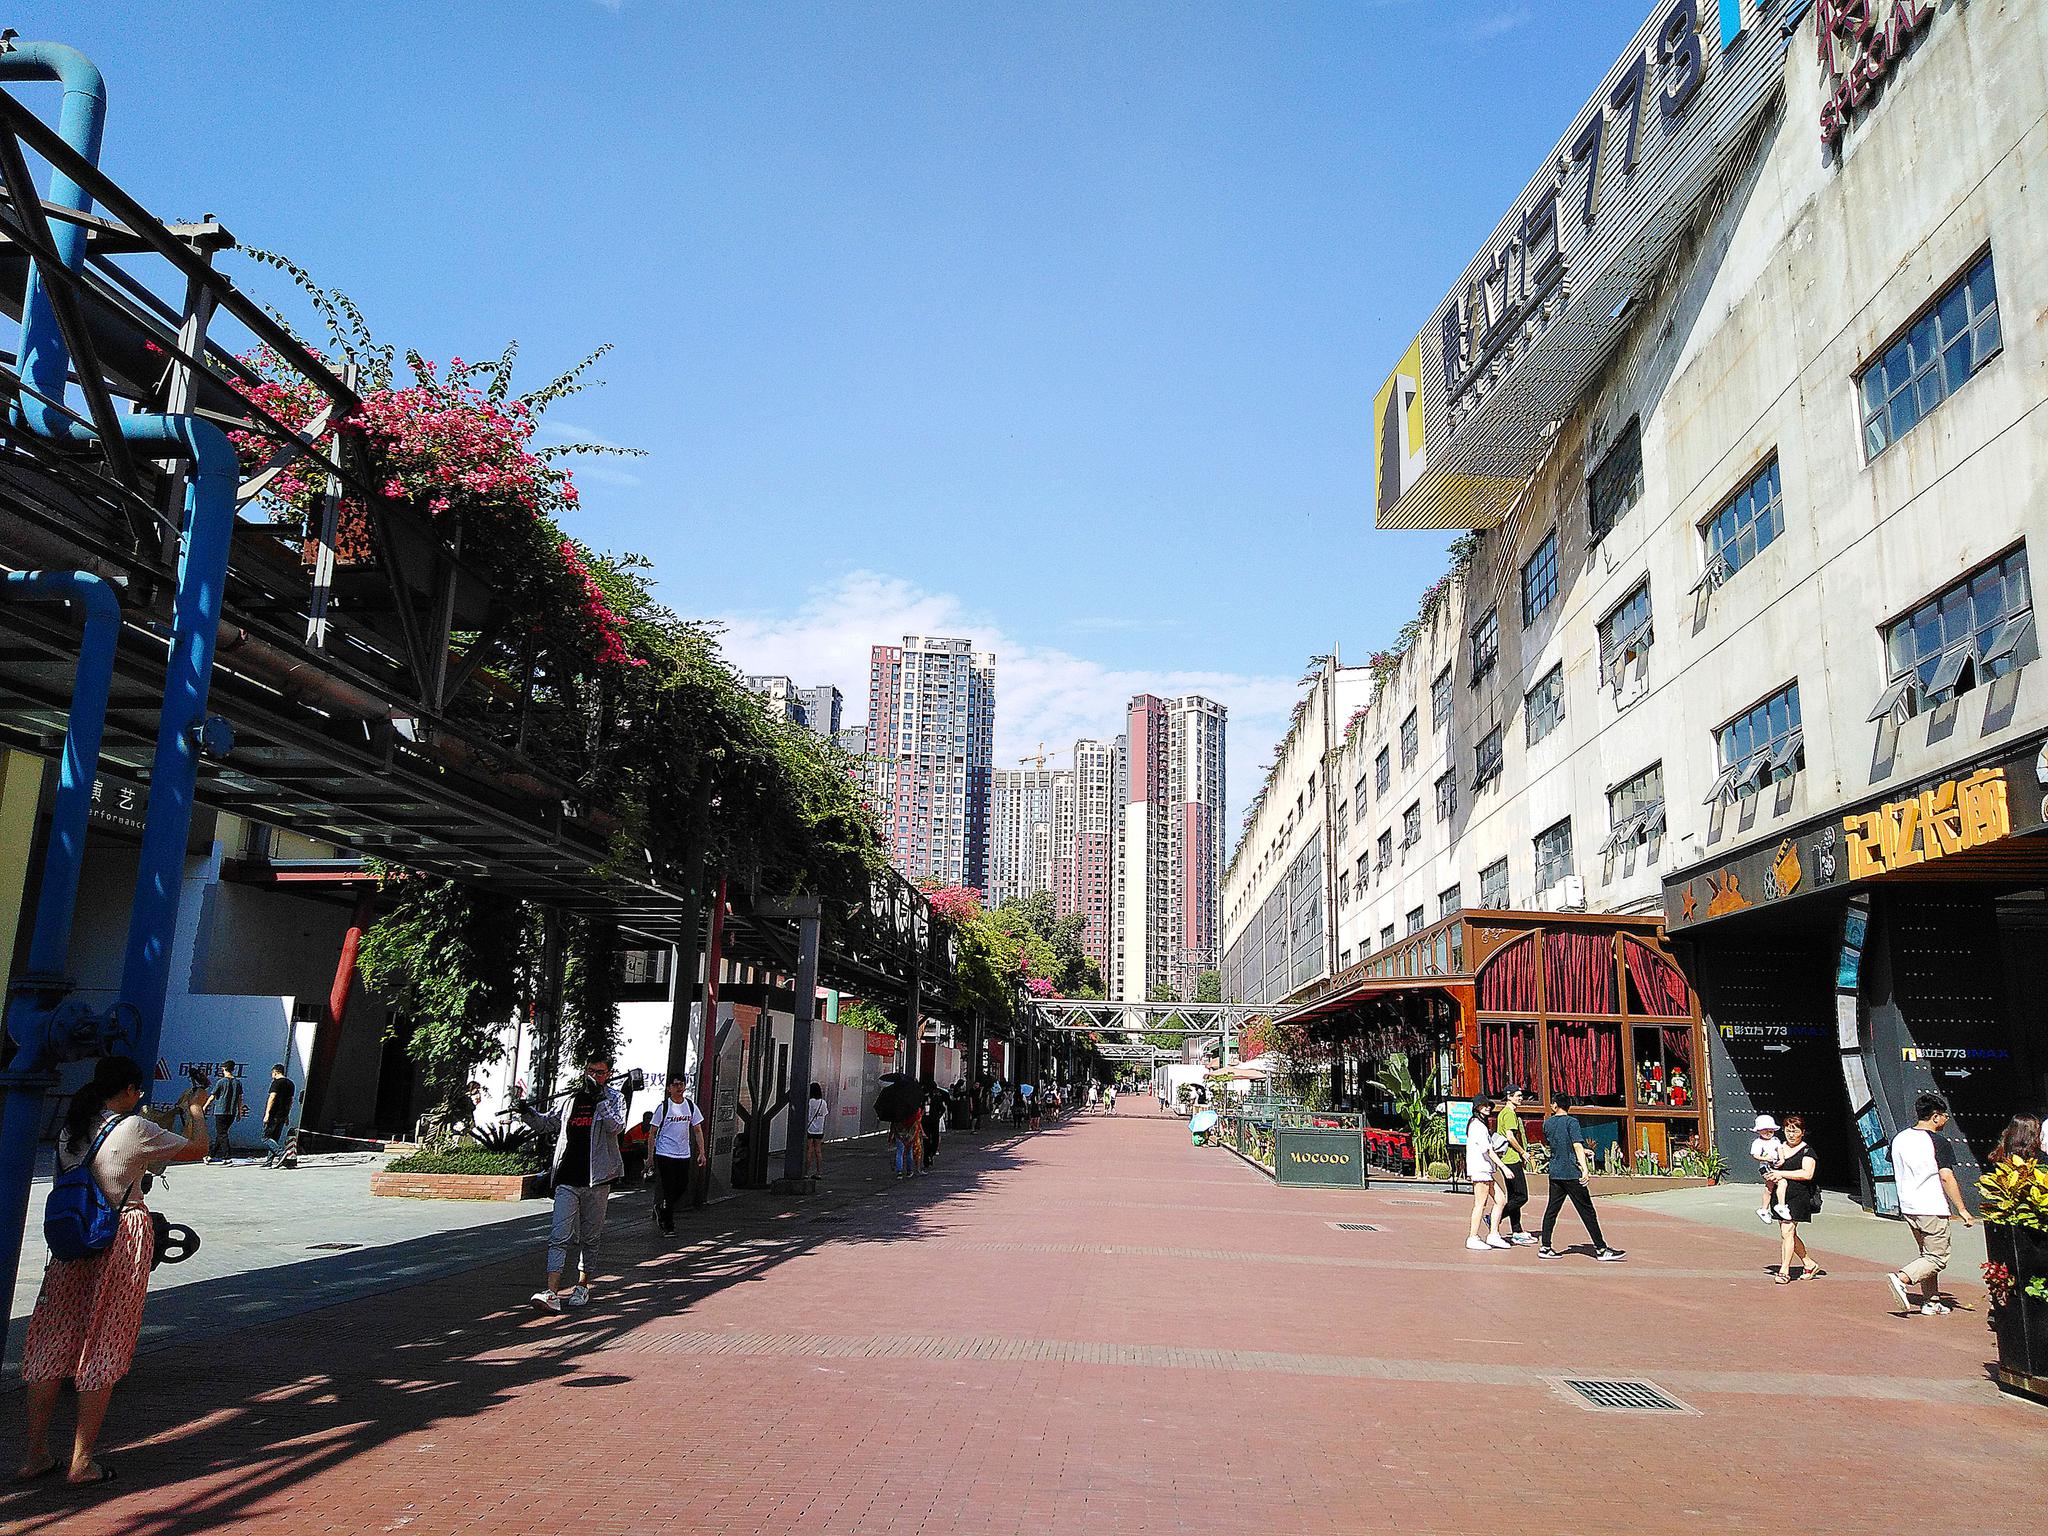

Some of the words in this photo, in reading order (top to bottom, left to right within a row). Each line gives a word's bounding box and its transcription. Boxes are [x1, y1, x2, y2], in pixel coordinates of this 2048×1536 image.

[1820, 0, 1934, 143] SPECIAL
[1571, 0, 1709, 224] 773
[1843, 767, 2011, 881] 记忆长廊
[1765, 1026, 1788, 1036] 773
[1944, 1049, 1967, 1058] 773
[1290, 1152, 1350, 1165] MOCOOO
